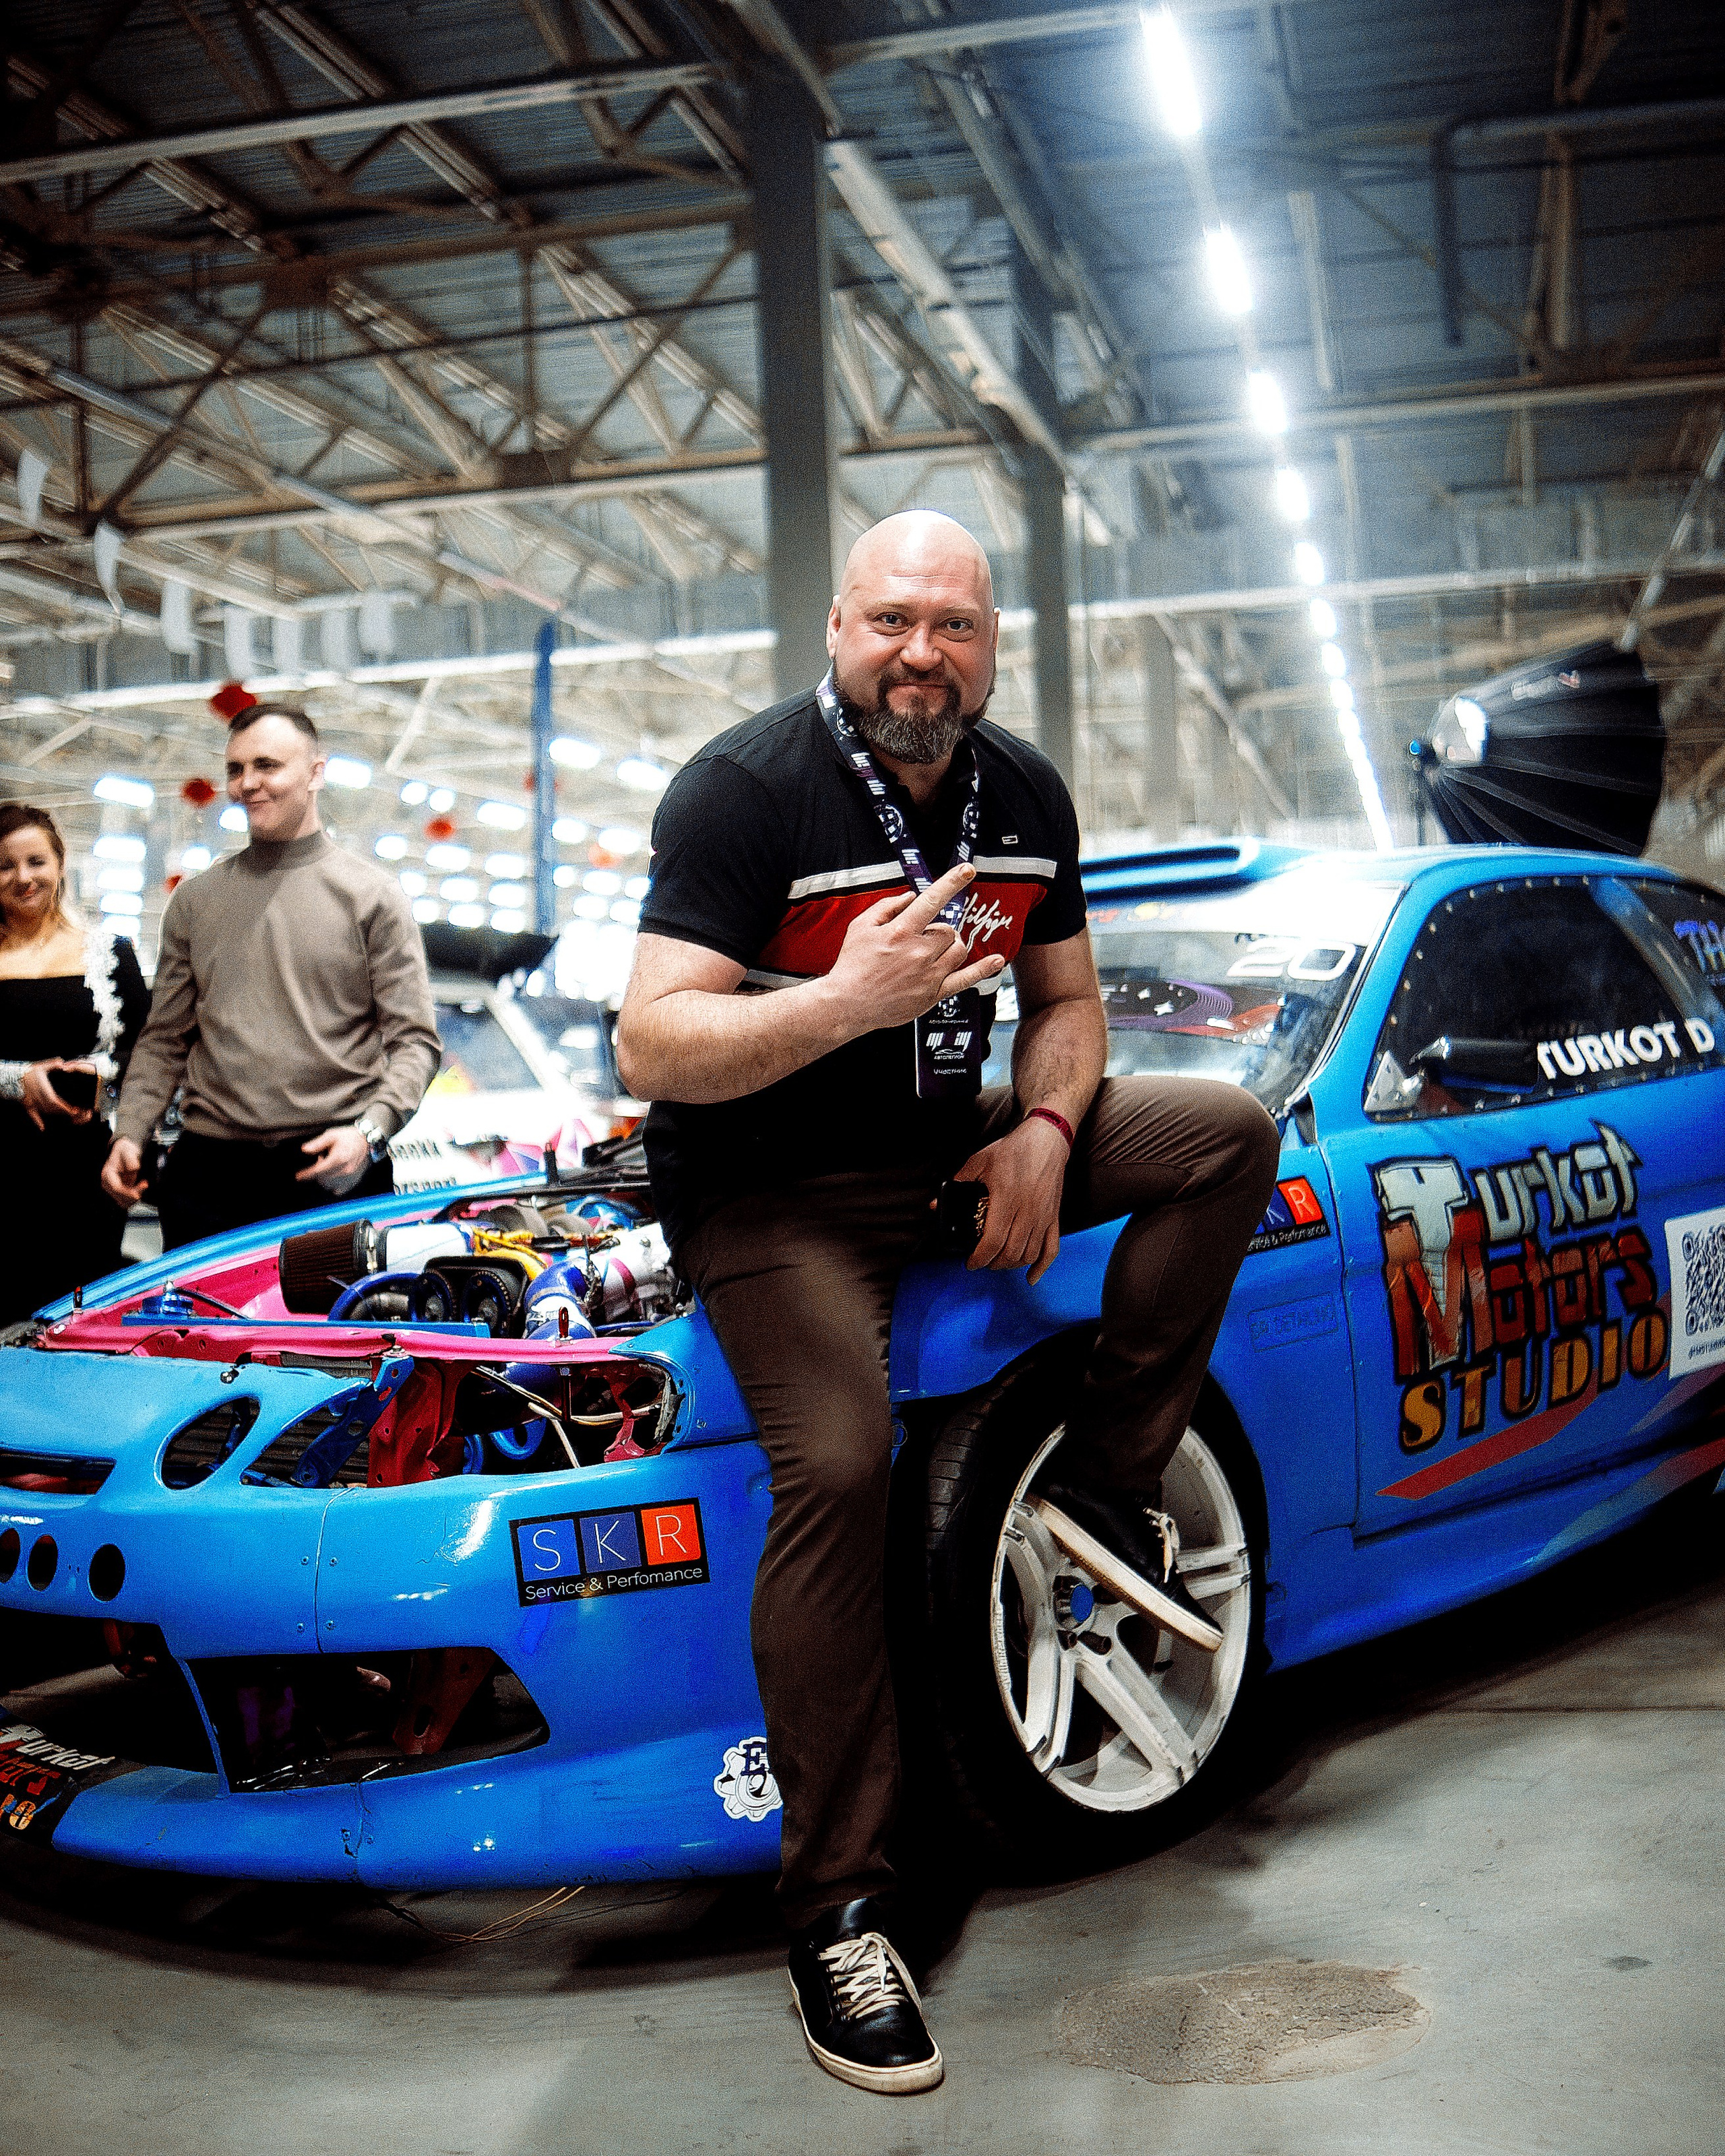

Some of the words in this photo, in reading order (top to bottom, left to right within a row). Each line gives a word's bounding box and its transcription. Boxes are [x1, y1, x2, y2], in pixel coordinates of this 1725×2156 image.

[1226, 936, 1356, 982] 20
[1537, 1021, 1681, 1080] TURKOT
[1375, 1120, 1643, 1252] Turkot
[1383, 1206, 1658, 1384] Motors
[1400, 1310, 1670, 1453] STUDIO
[525, 1581, 585, 1601] Service
[589, 1577, 604, 1591] &
[607, 1567, 703, 1589] Perfomance
